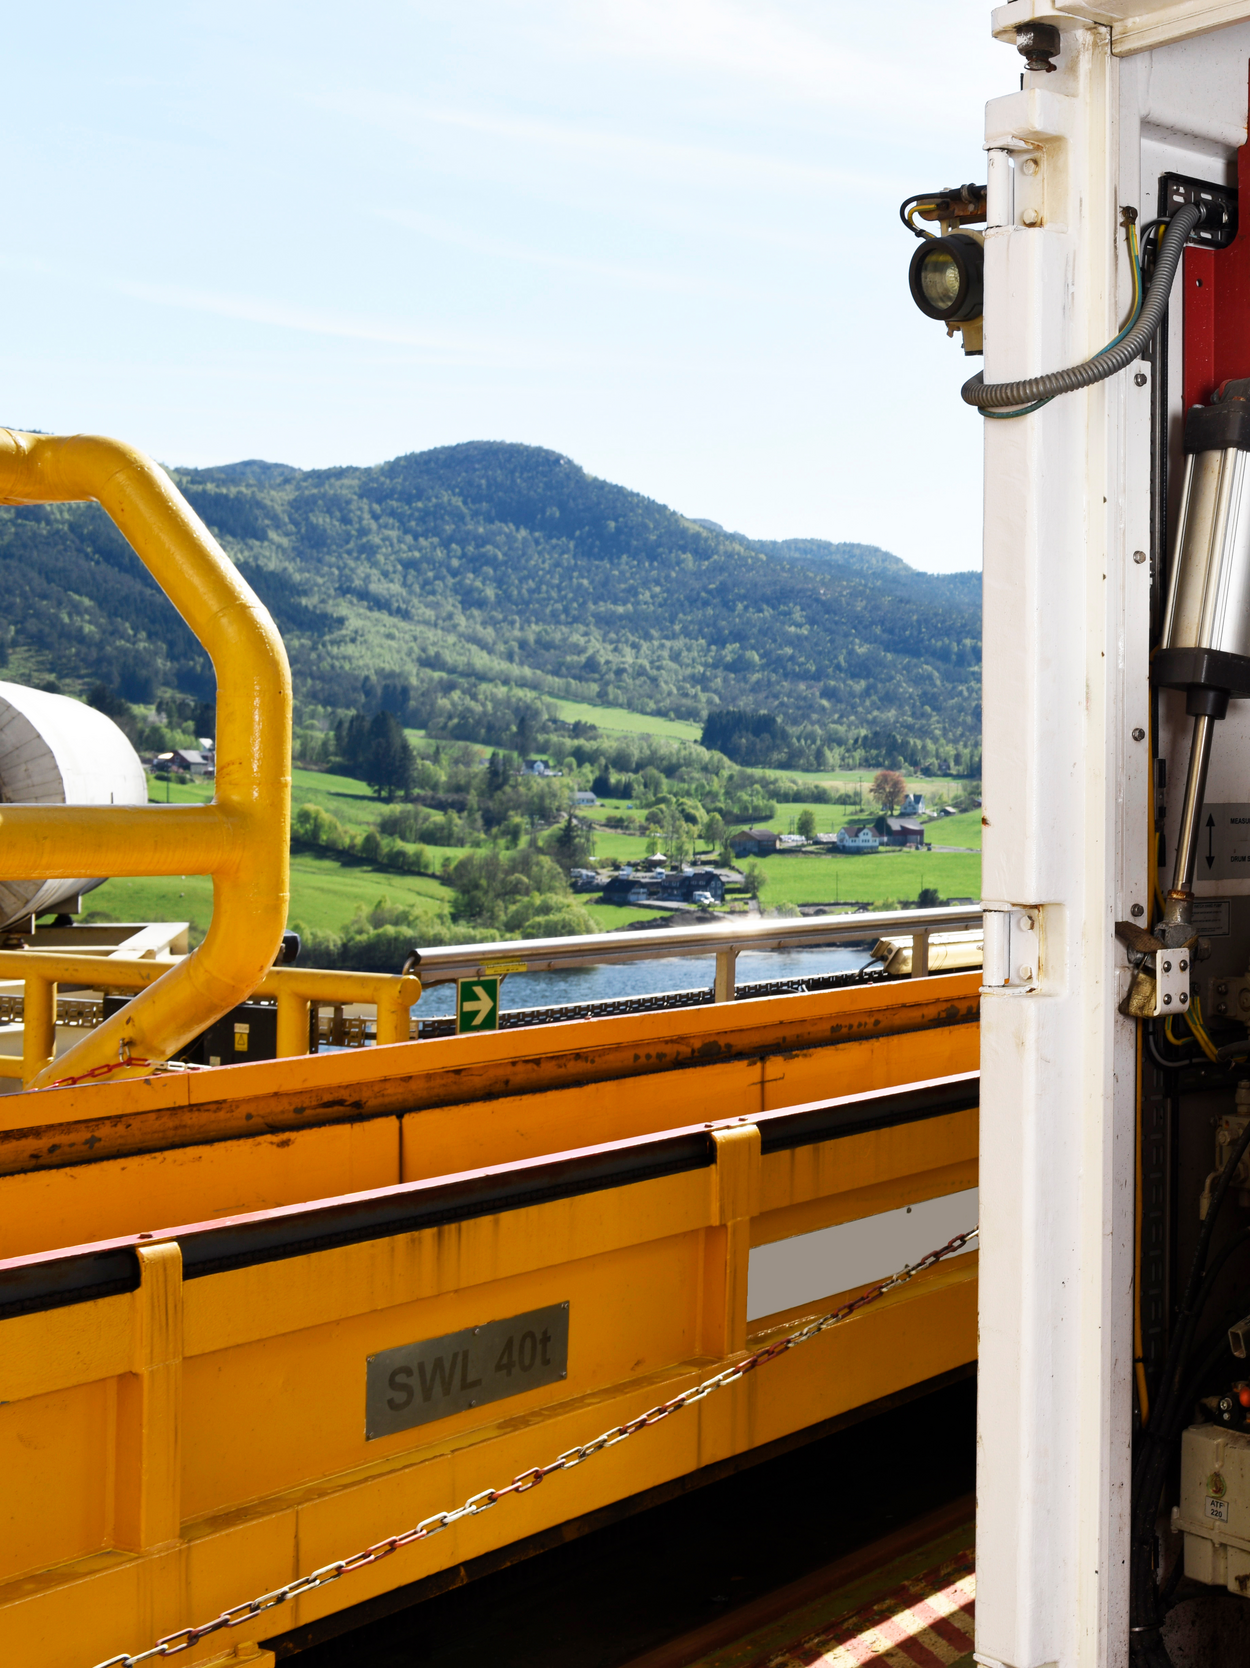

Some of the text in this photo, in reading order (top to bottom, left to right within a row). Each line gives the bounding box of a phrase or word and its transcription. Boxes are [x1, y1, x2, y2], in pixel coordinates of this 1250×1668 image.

[386, 1327, 551, 1412] SWL 40t
[1210, 1500, 1223, 1508] ATF
[1210, 1509, 1223, 1518] 220
